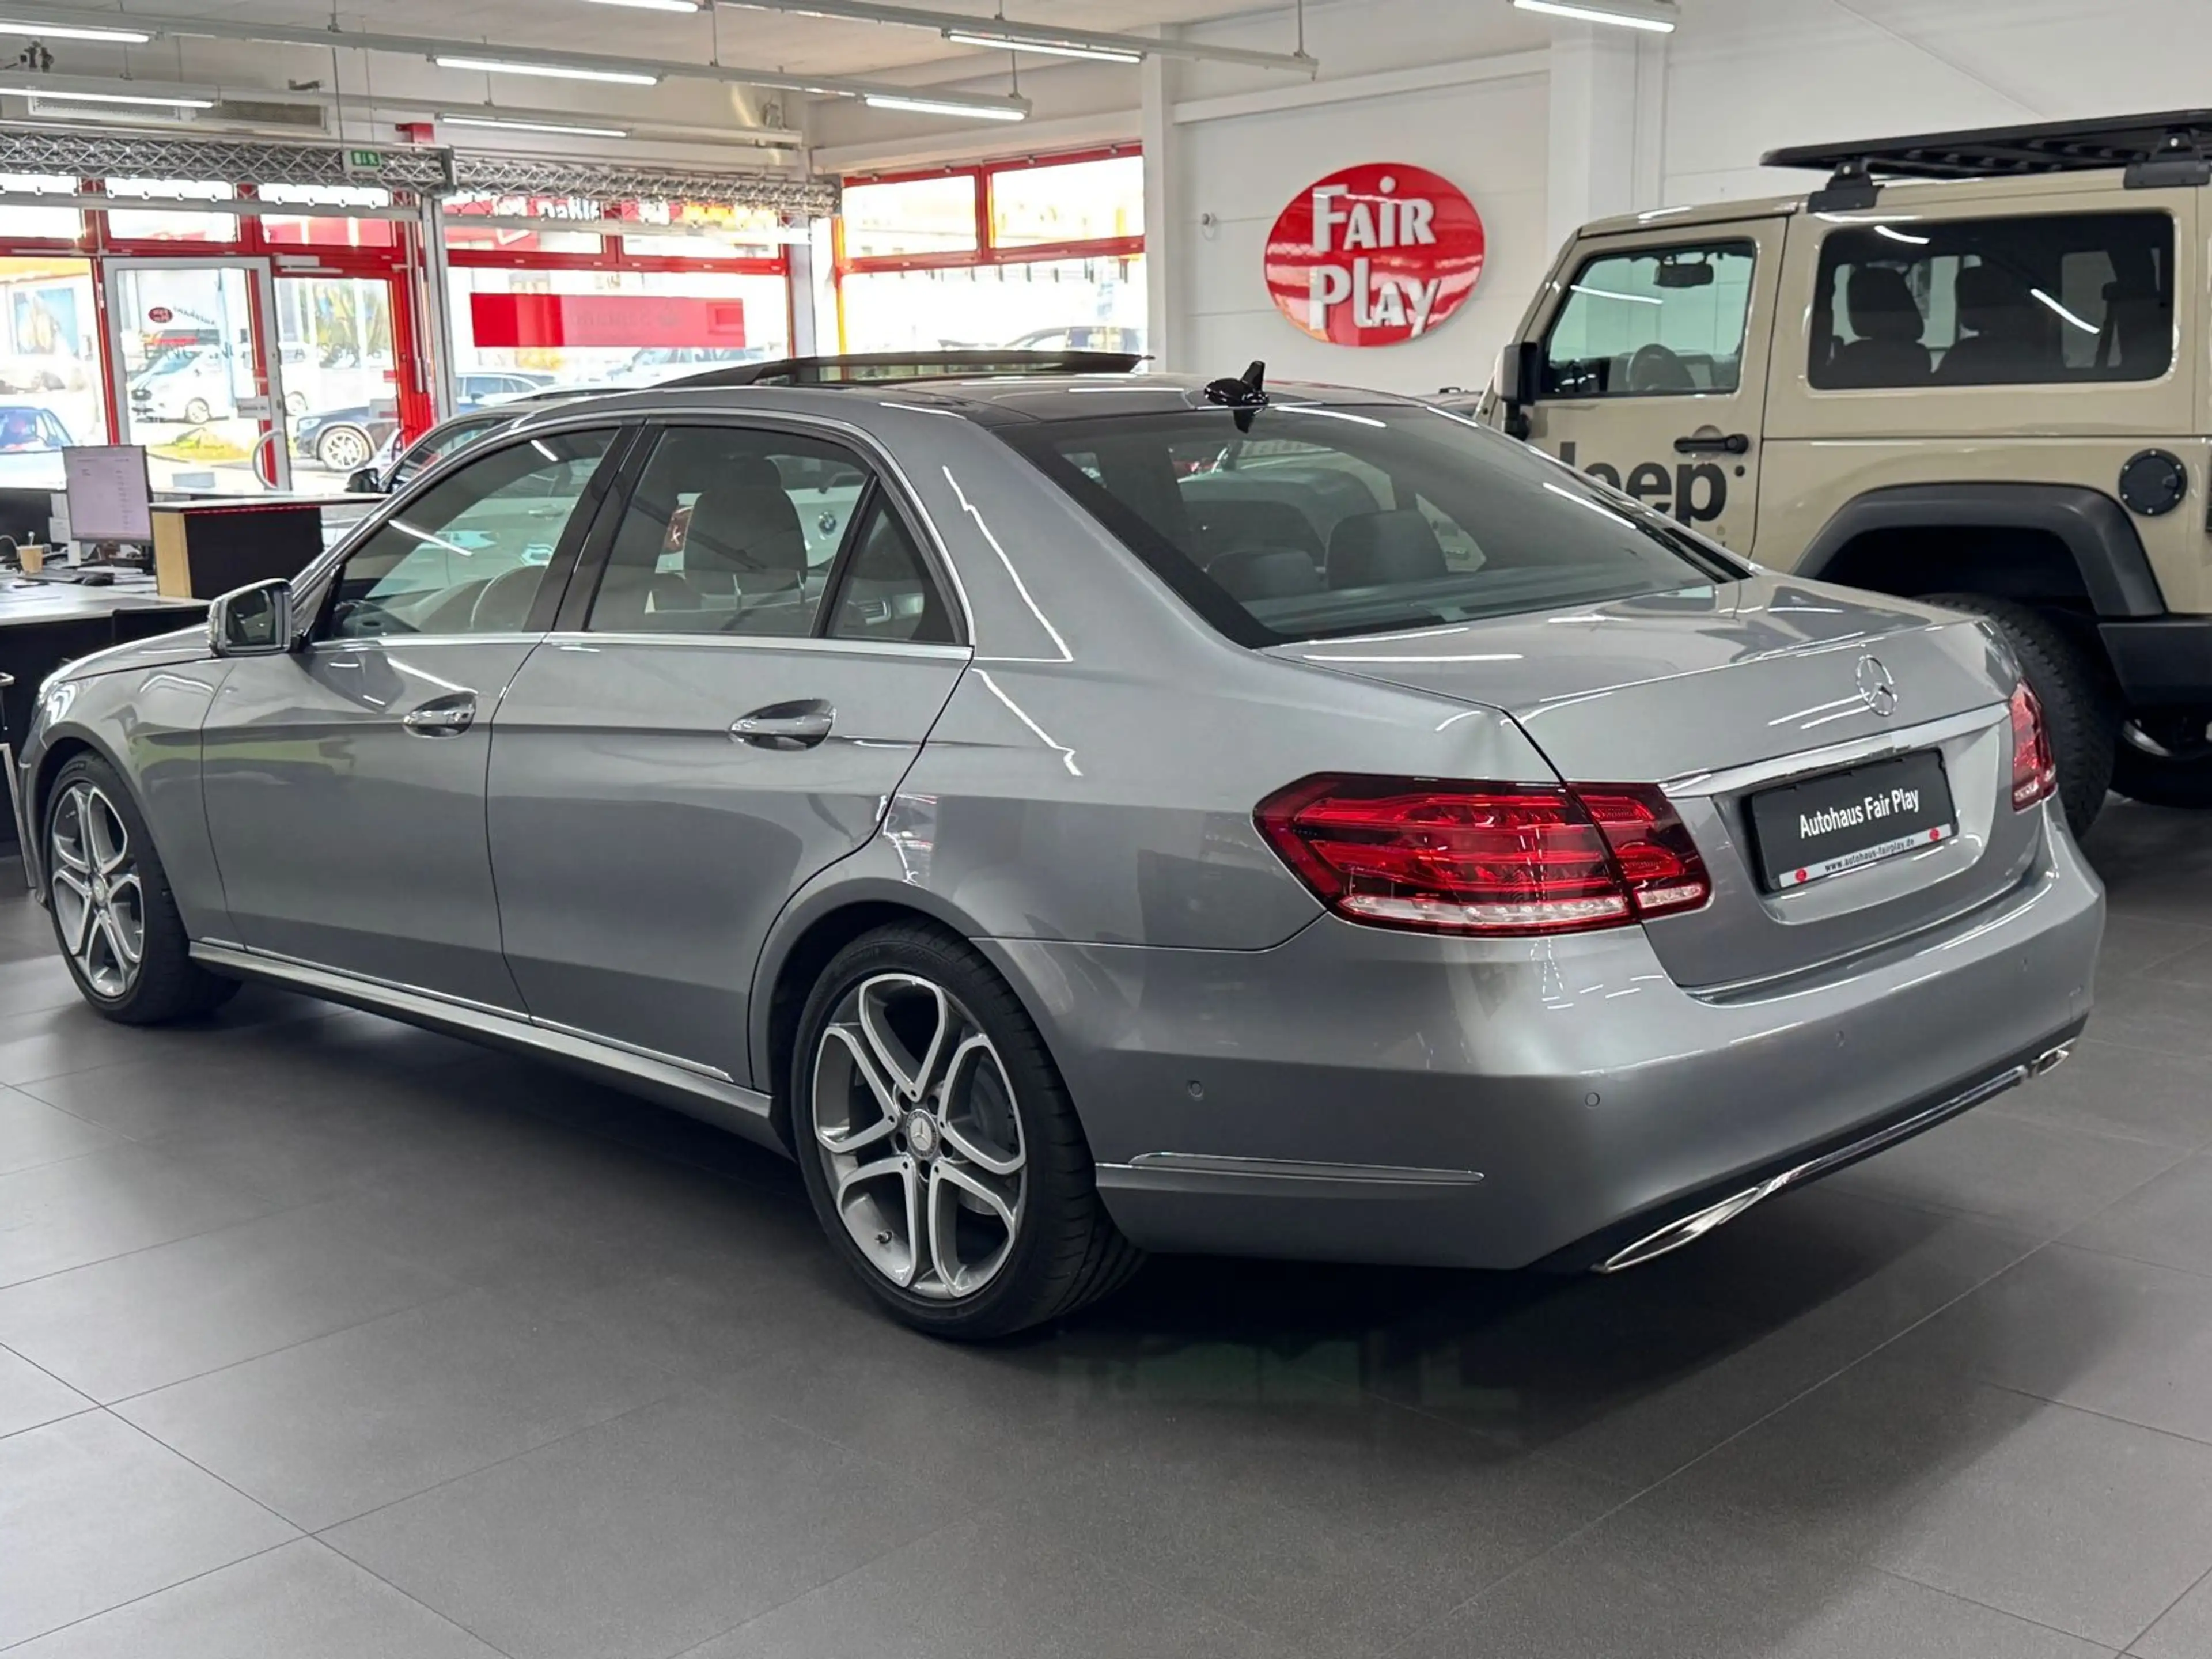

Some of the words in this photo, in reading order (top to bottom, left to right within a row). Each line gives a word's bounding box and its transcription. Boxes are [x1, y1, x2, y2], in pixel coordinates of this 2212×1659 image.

[1799, 805, 1864, 839] Autohaus
[1864, 793, 1891, 821] Fair
[1891, 787, 1919, 813] Play
[1824, 838, 1914, 872] www.autohaus-fairplay.de
